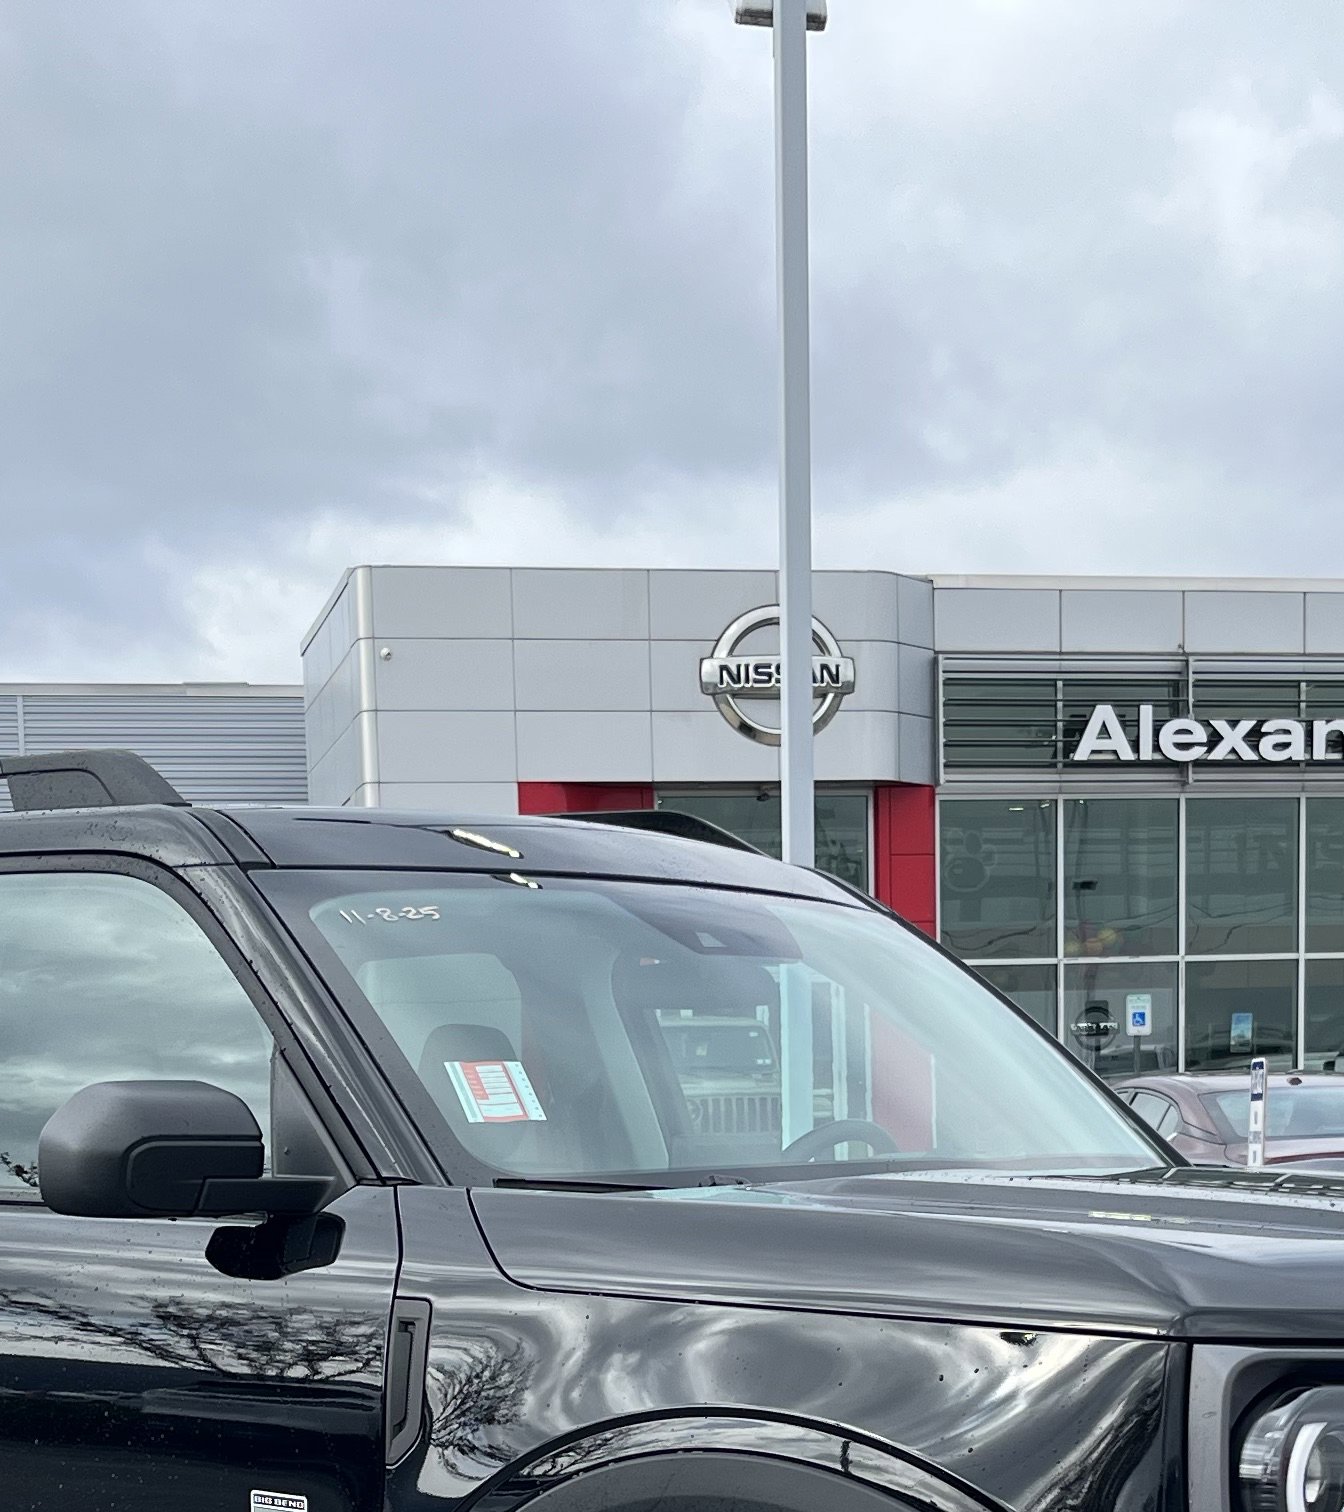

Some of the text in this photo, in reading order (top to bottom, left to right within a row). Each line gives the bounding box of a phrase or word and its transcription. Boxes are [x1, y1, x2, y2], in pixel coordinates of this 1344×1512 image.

[718, 662, 841, 687] NISN
[339, 905, 440, 926] 11-8-25
[254, 1495, 305, 1509] BIG BEND
